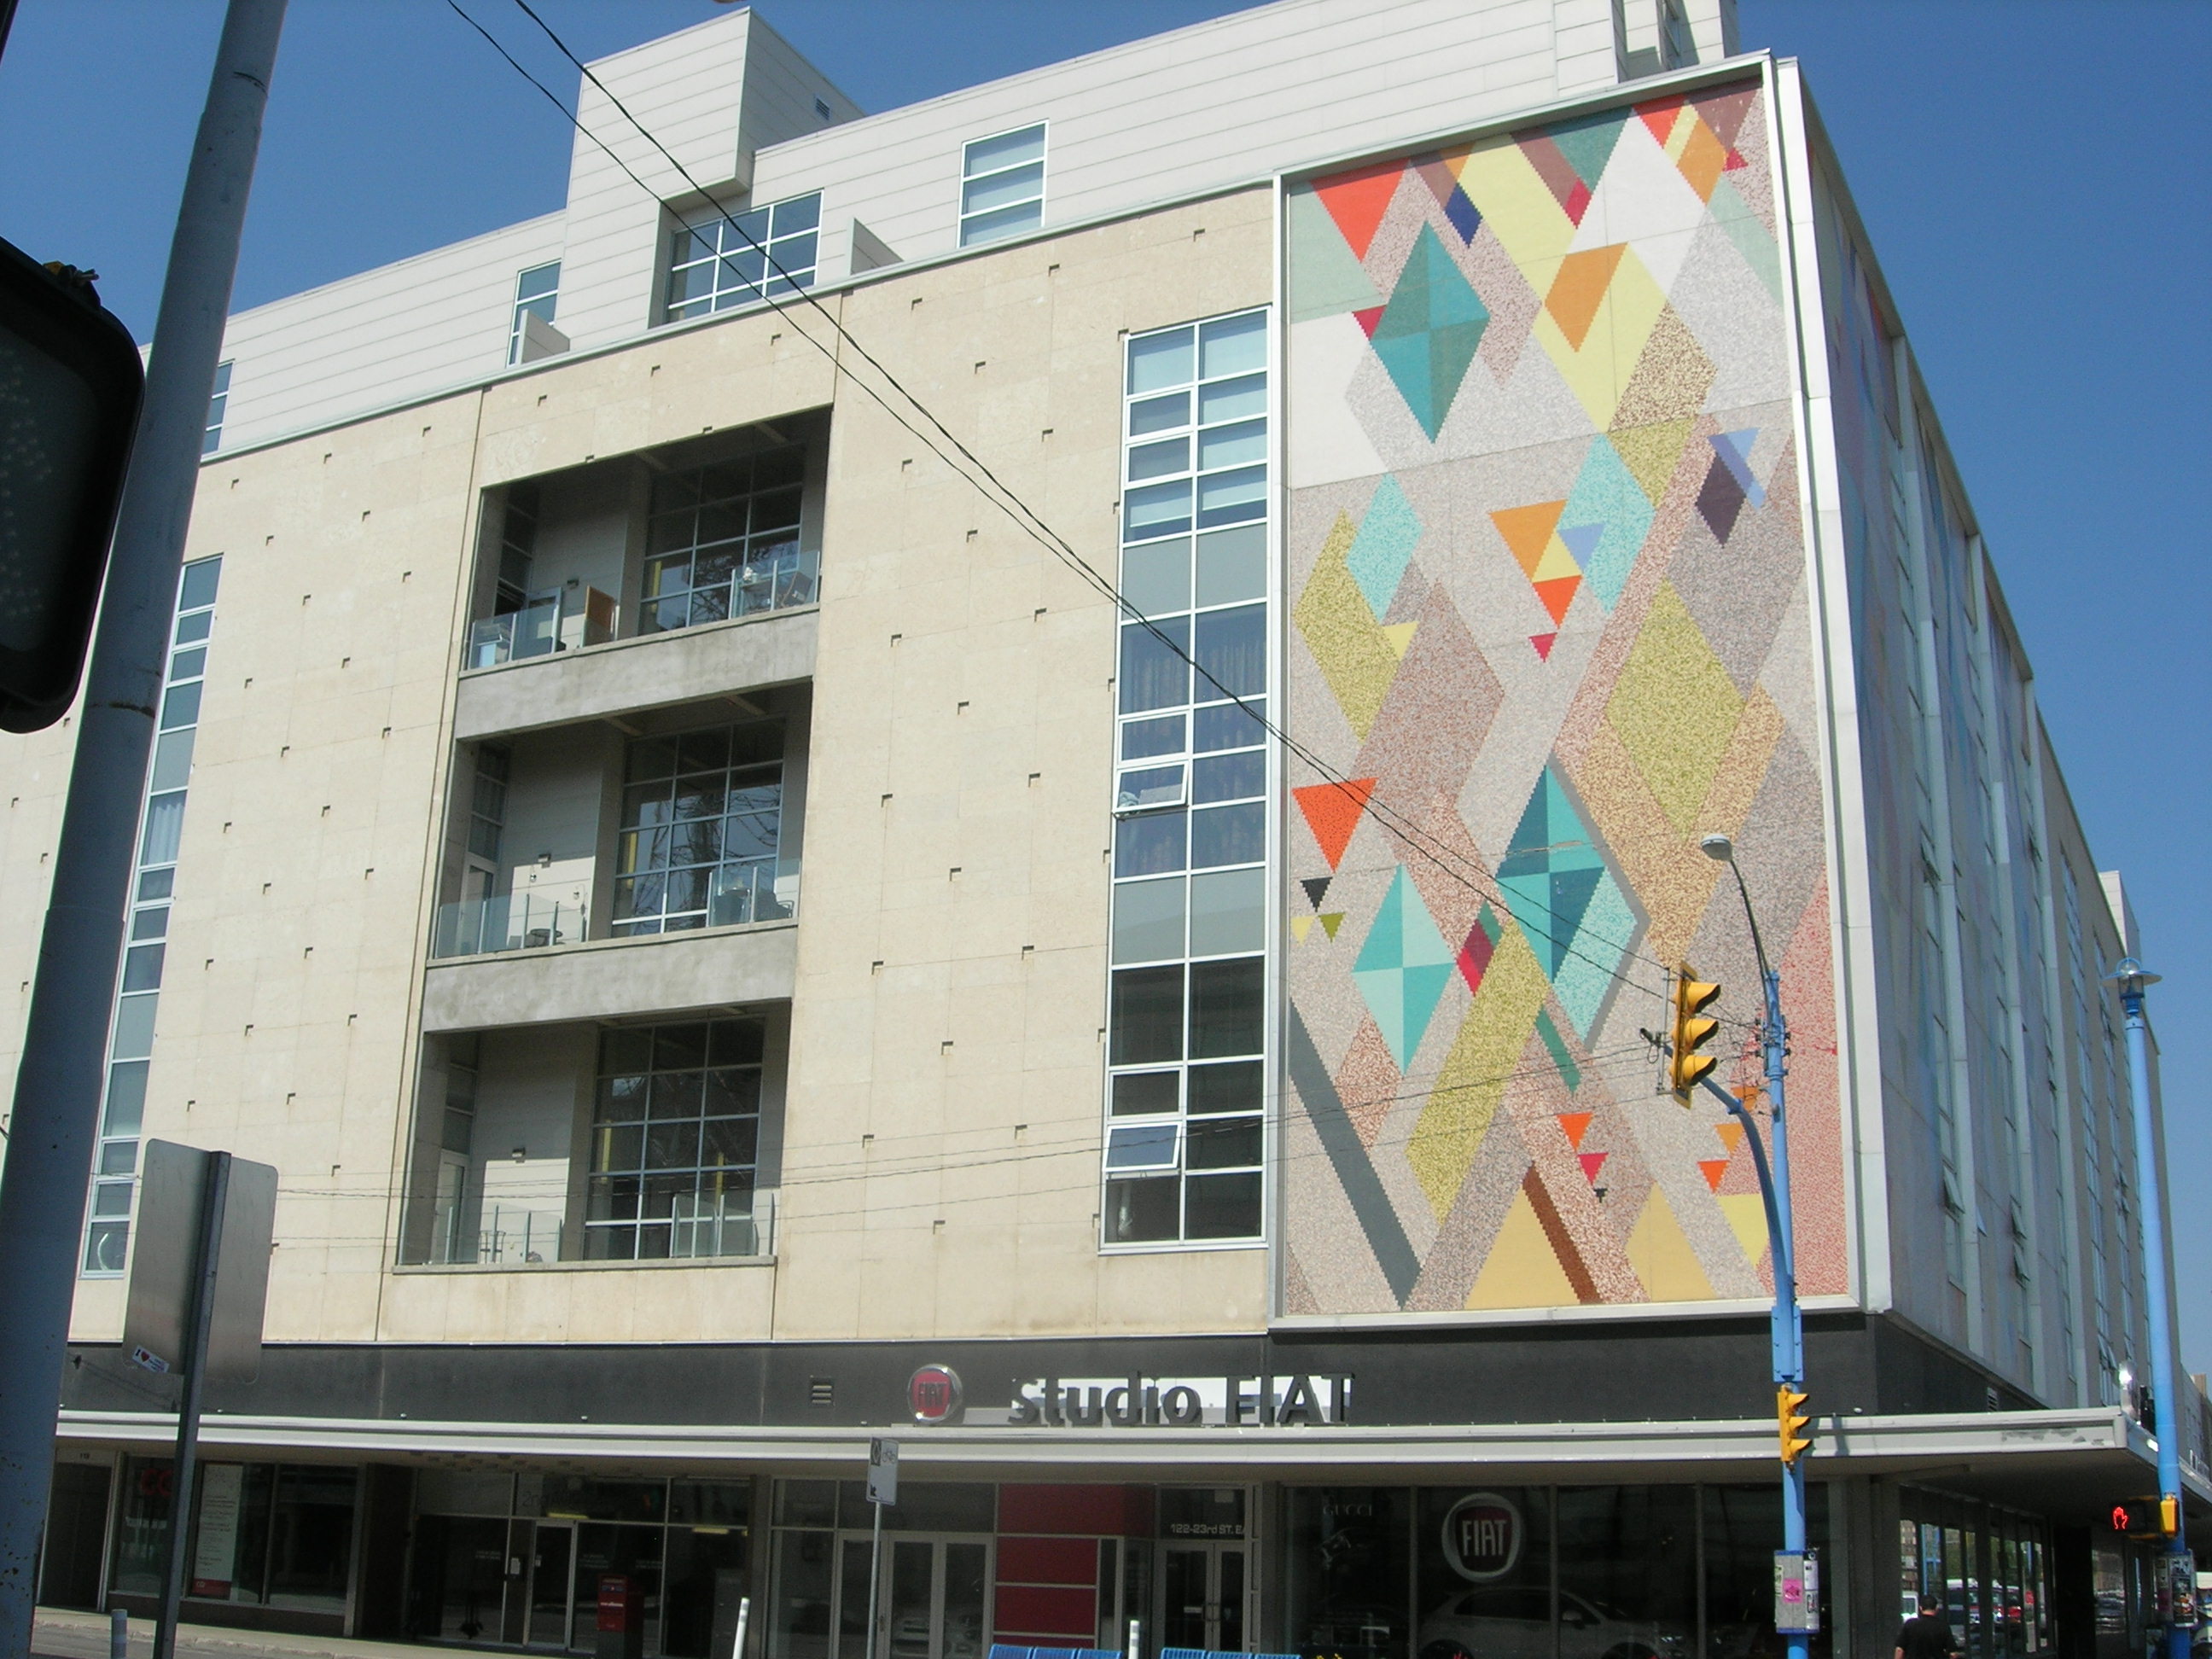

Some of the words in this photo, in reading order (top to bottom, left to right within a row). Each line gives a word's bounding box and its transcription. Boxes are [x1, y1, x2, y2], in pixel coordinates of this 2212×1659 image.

[916, 1381, 948, 1408] FIAT
[1225, 1372, 1355, 1424] FIAT
[1323, 1502, 1372, 1516] GUCCI
[1462, 1519, 1507, 1557] FIAT
